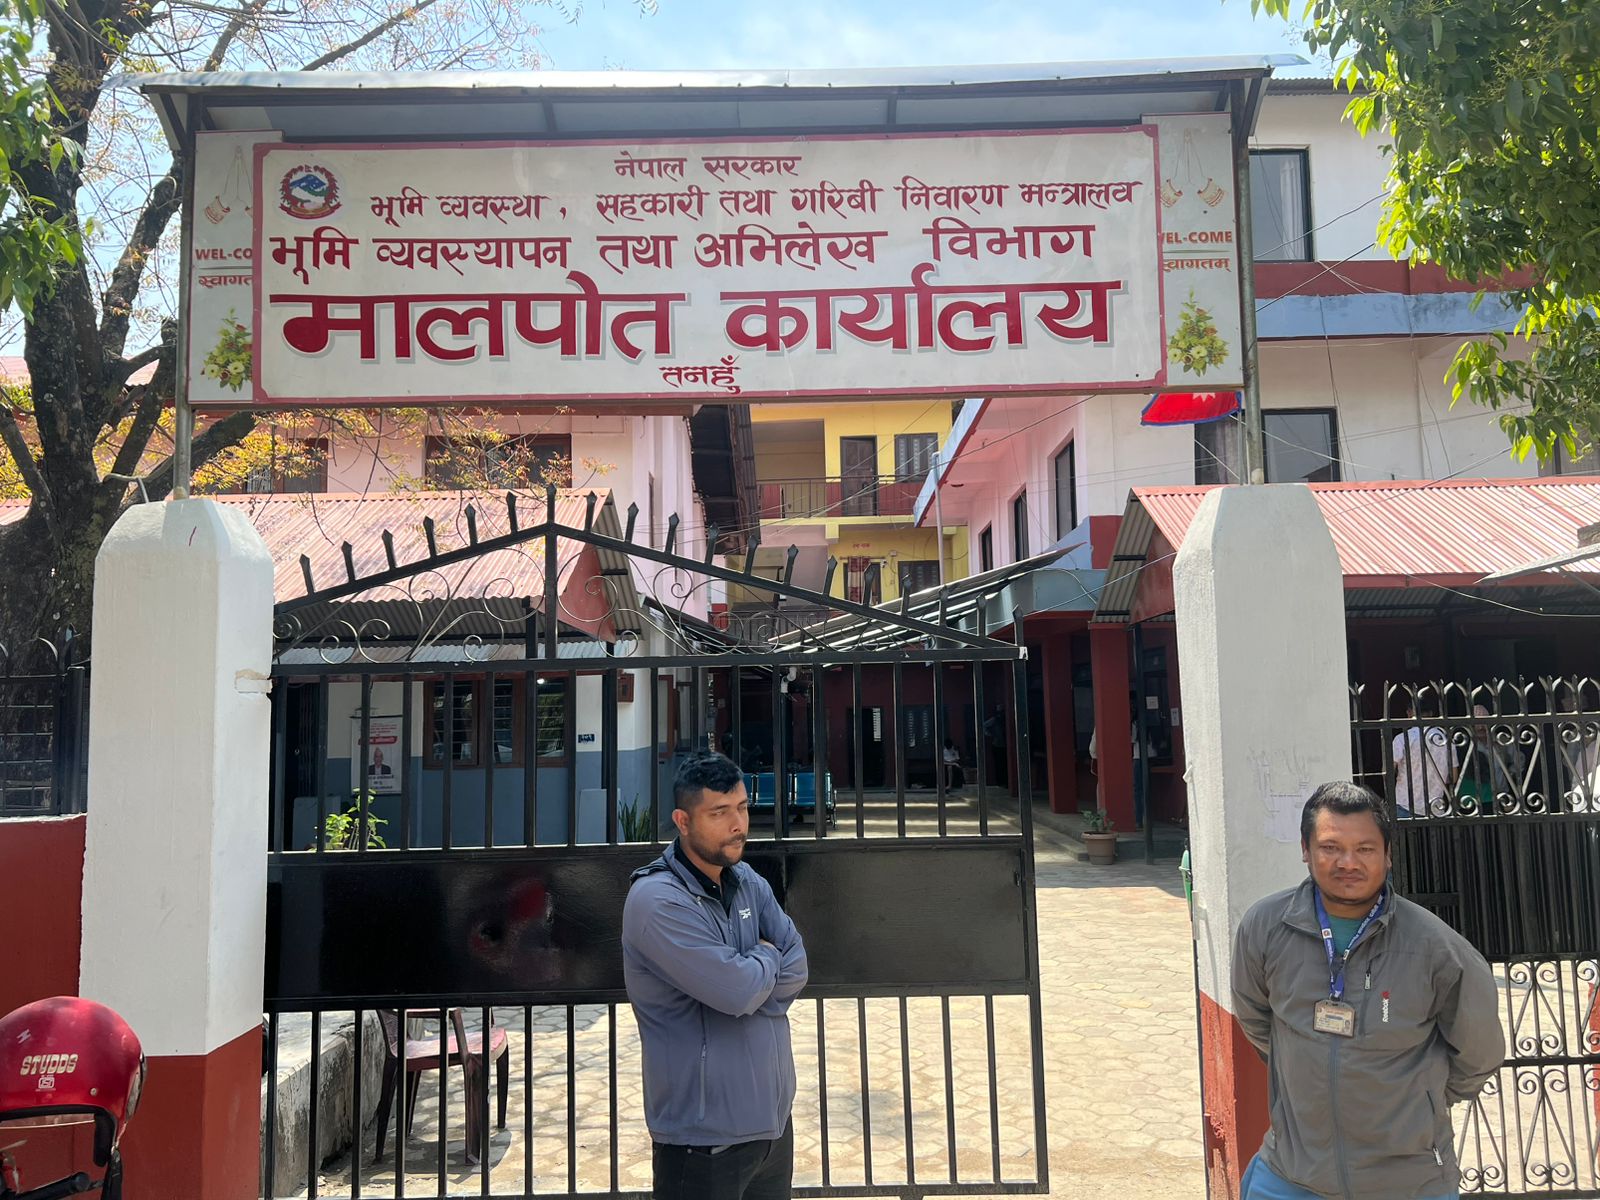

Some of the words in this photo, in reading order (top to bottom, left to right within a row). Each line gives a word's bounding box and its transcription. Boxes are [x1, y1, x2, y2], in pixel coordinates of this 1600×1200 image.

[614, 150, 688, 182] नेपाल
[701, 156, 803, 182] सरकार
[370, 186, 430, 228] भूमि
[436, 194, 552, 225] व्यवस्था
[596, 184, 710, 223] सहकारी
[718, 189, 778, 217] तथा
[790, 179, 884, 219] गरिबी
[893, 175, 1010, 215] निवारण
[269, 225, 360, 286] भूमि
[371, 236, 573, 277] व्यवस्थापन
[596, 234, 679, 275] तथा
[694, 221, 889, 271] अभिलेख
[921, 216, 1096, 260] विभाग
[269, 269, 686, 361] मालपोत
[719, 262, 1123, 352] कार्यालय
[20, 1053, 79, 1076] STUDDS
